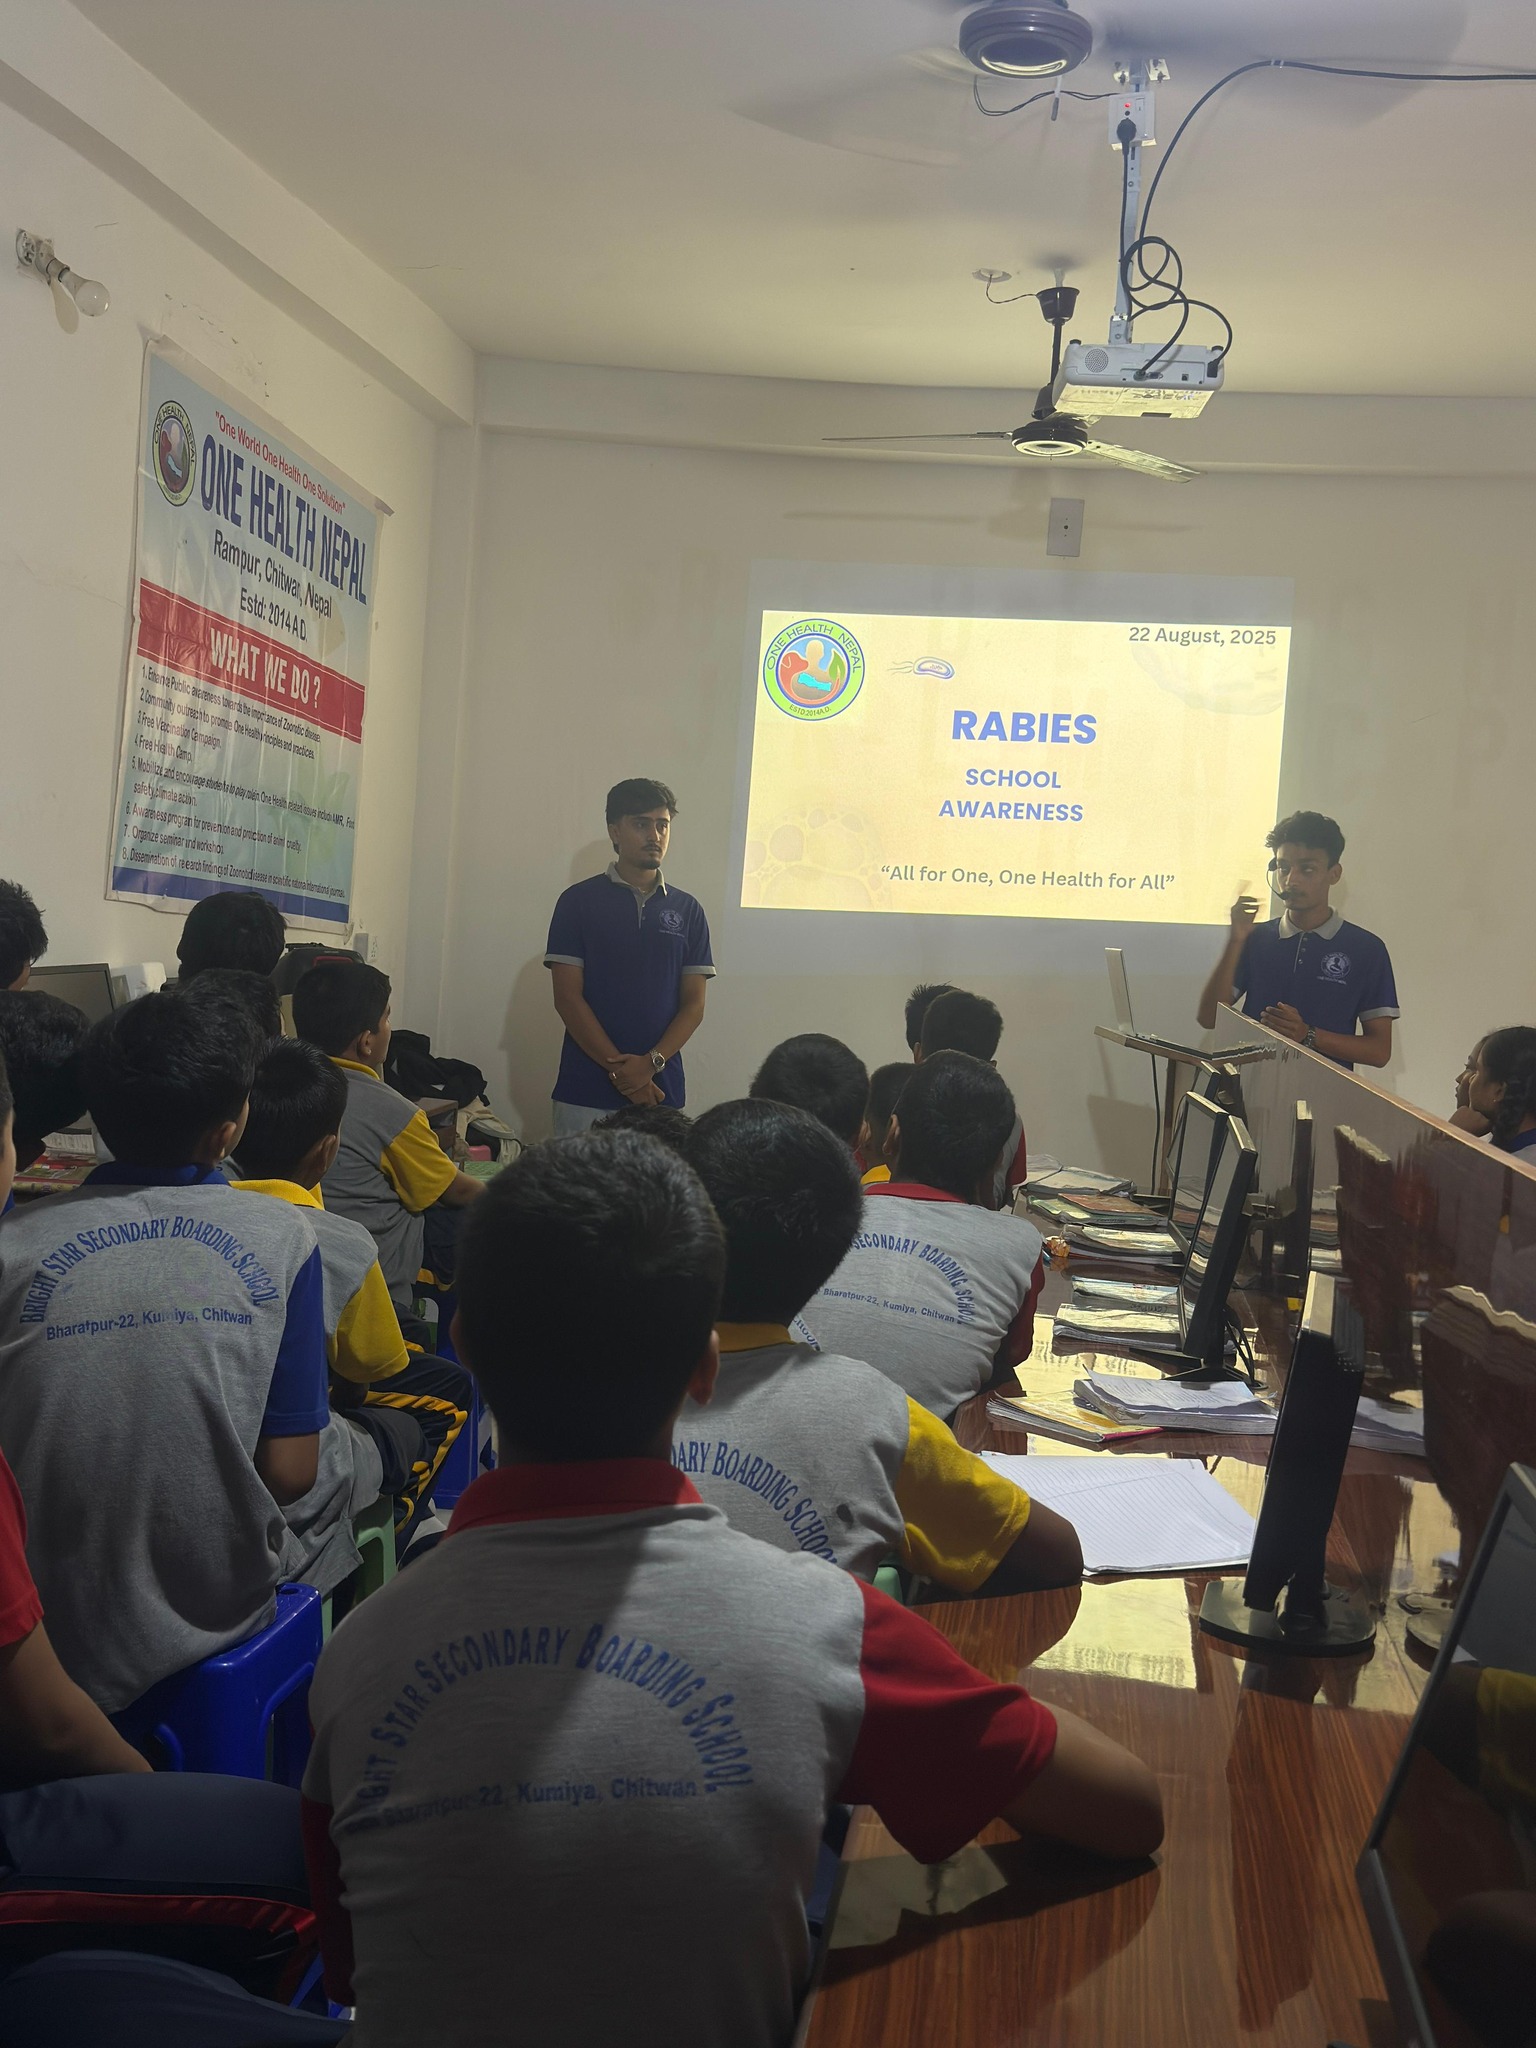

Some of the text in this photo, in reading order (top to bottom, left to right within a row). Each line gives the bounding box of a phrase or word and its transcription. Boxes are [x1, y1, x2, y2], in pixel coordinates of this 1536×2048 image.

[237, 426, 261, 456] World
[262, 444, 278, 467] One
[279, 455, 301, 485] Health
[302, 474, 317, 496] One
[200, 434, 367, 605] ONE HEALTH NEPAL
[213, 529, 262, 582] Rampur,
[304, 582, 332, 619] Nepal
[240, 586, 266, 620] Estd:
[766, 624, 862, 674] ONE HEALTH NEPAL
[1129, 627, 1276, 647] 22 August, 2025
[210, 627, 321, 708] WHAT WE DO ?
[171, 676, 190, 695] Public
[191, 686, 221, 705] awareness
[141, 711, 155, 729] Free
[203, 710, 210, 723] to
[233, 719, 244, 733] One
[951, 710, 1098, 744] RABIES
[139, 734, 153, 752] Free
[965, 768, 1061, 789] SCHOOL
[132, 803, 167, 822] Awareness
[938, 800, 1084, 822] AWARENESS
[170, 855, 177, 867] of
[880, 865, 1175, 891] “All for One, One Health for All”
[20, 1216, 280, 1323] BRIGHT STAR SECONDARY BOARDING SCHOOL
[918, 1243, 968, 1288] BOARDING
[954, 1289, 977, 1326] SCHOOL
[823, 1287, 955, 1323] Bharatpur-22, Kumiya, Chitwan
[46, 1307, 252, 1340] Bharatpur-22, Kuiya, Chitwan
[712, 1441, 798, 1511] BOARDING
[783, 1498, 837, 1563] SCHOO
[370, 1684, 432, 1748] STAR
[414, 1626, 571, 1694] SECONDARY
[575, 1622, 706, 1709] BOARDING
[682, 1693, 754, 1795] SCHOOL
[517, 1778, 602, 1807] Kumiya,
[611, 1776, 697, 1800] Chitwan
